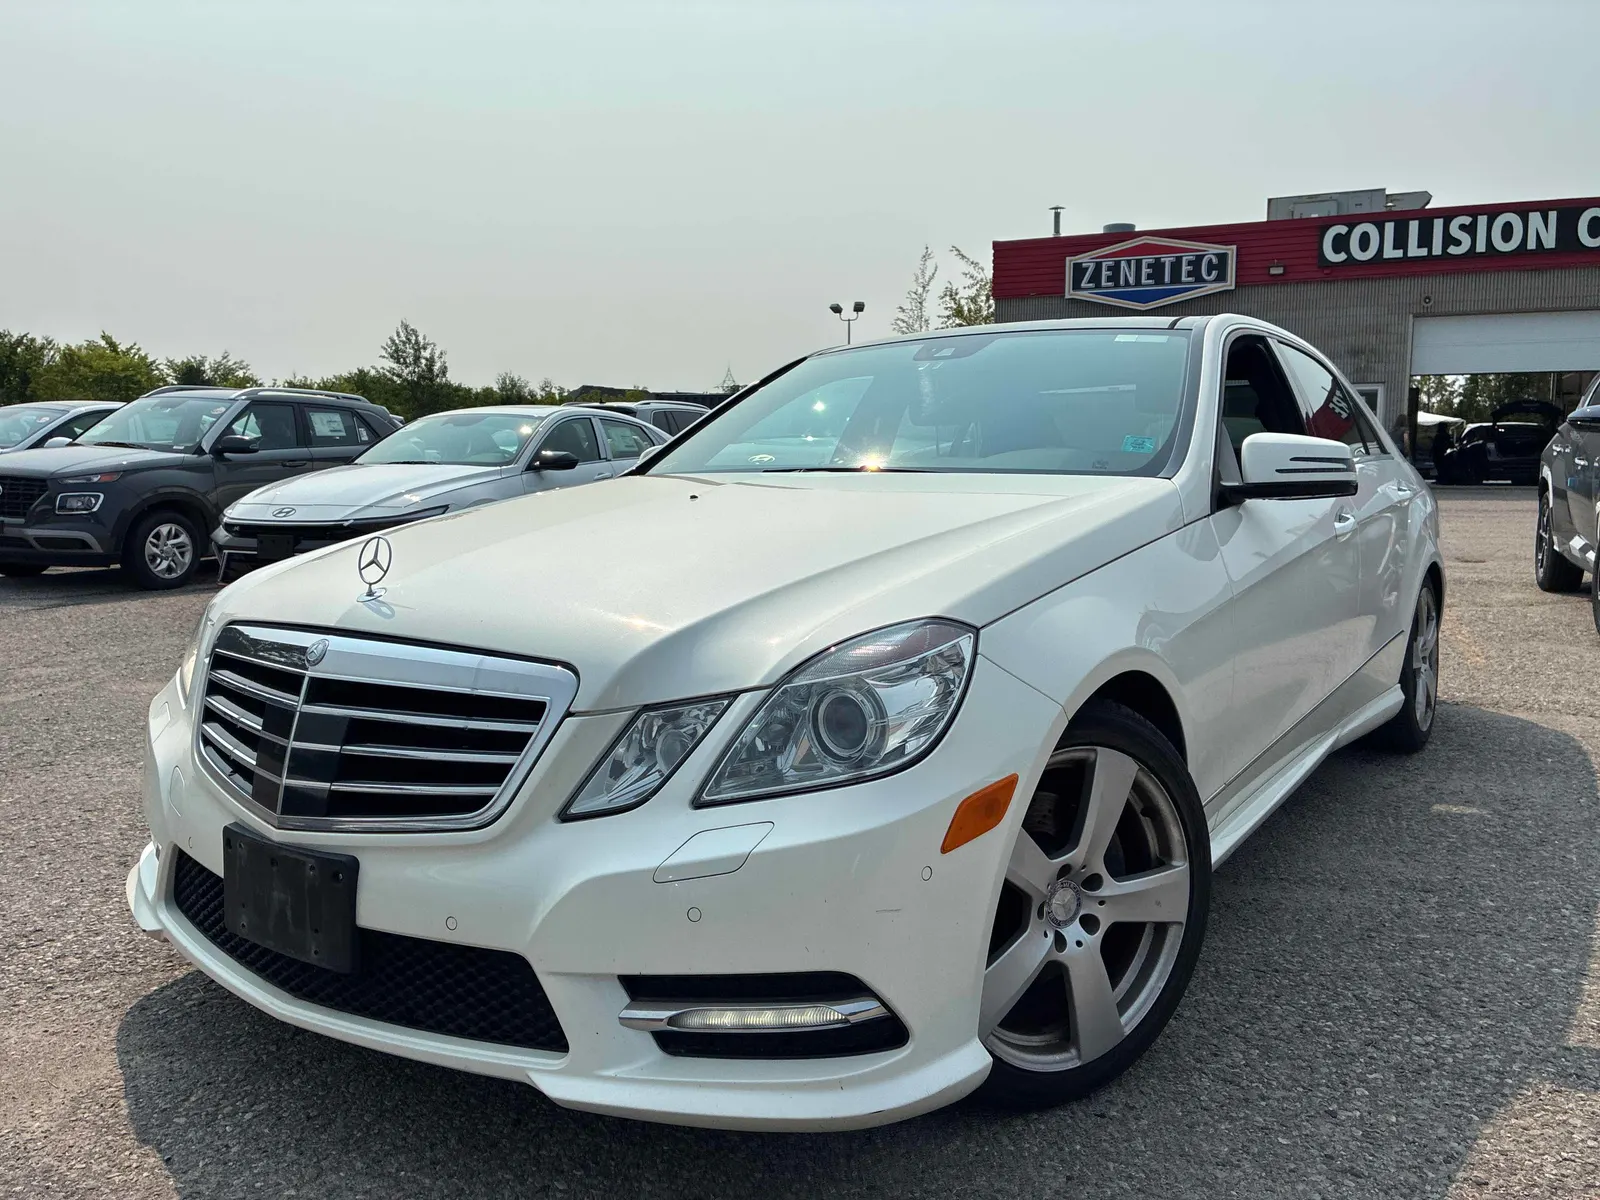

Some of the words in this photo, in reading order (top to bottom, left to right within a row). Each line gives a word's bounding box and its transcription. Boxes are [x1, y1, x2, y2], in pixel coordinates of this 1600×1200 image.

[1322, 210, 1557, 263] COLLISION
[1577, 207, 1600, 248] C
[1080, 254, 1219, 289] ZENETEC
